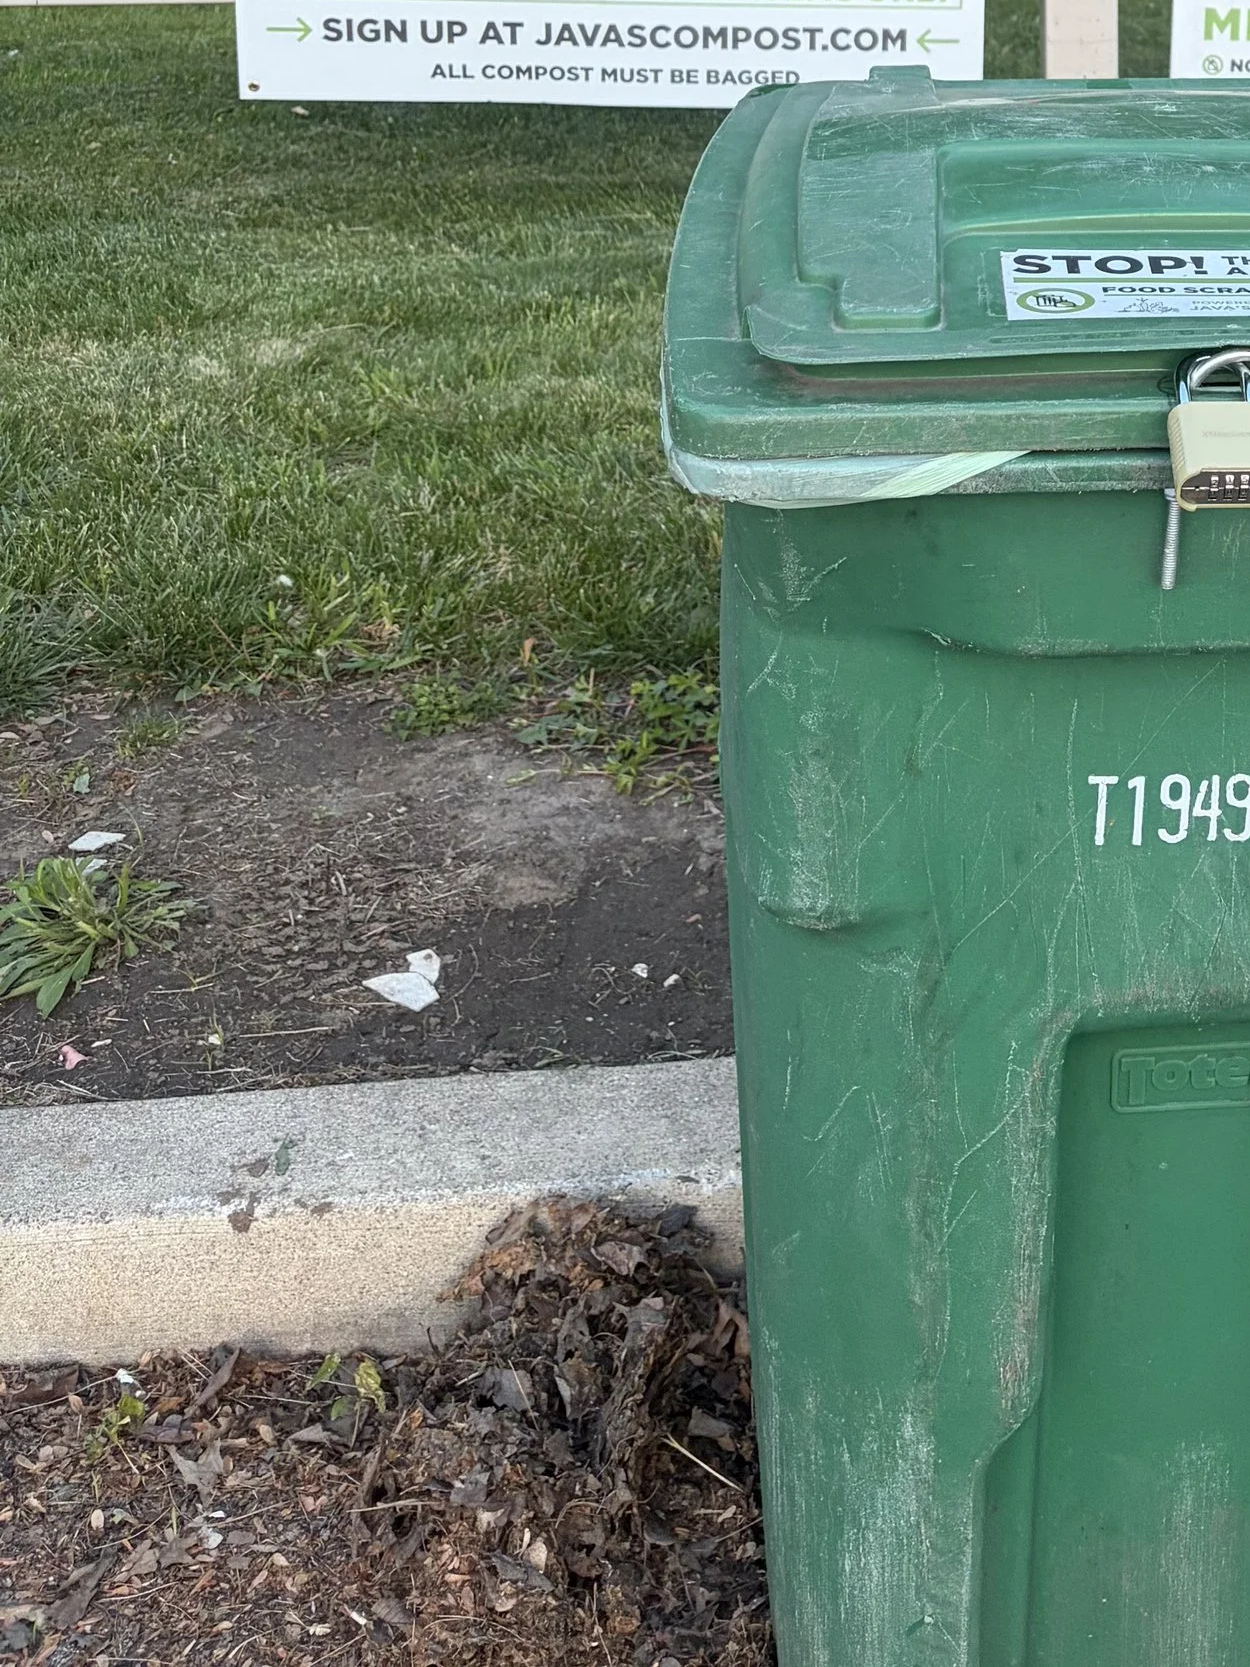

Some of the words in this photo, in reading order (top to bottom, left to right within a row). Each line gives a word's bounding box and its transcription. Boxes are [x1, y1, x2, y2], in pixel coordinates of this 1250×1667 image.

[323, 18, 407, 42] SIGN
[421, 20, 467, 43] UP
[479, 22, 523, 45] AT
[536, 23, 906, 51] JAVASCOMPOST.COM
[431, 64, 474, 78] ALL
[482, 65, 593, 81] COMPOST
[601, 68, 663, 83] MUST
[671, 69, 699, 84] BE
[706, 69, 800, 84] BAGGED
[1013, 255, 1208, 274] STOP!
[1227, 267, 1248, 275] A
[1102, 286, 1175, 294] FOOD
